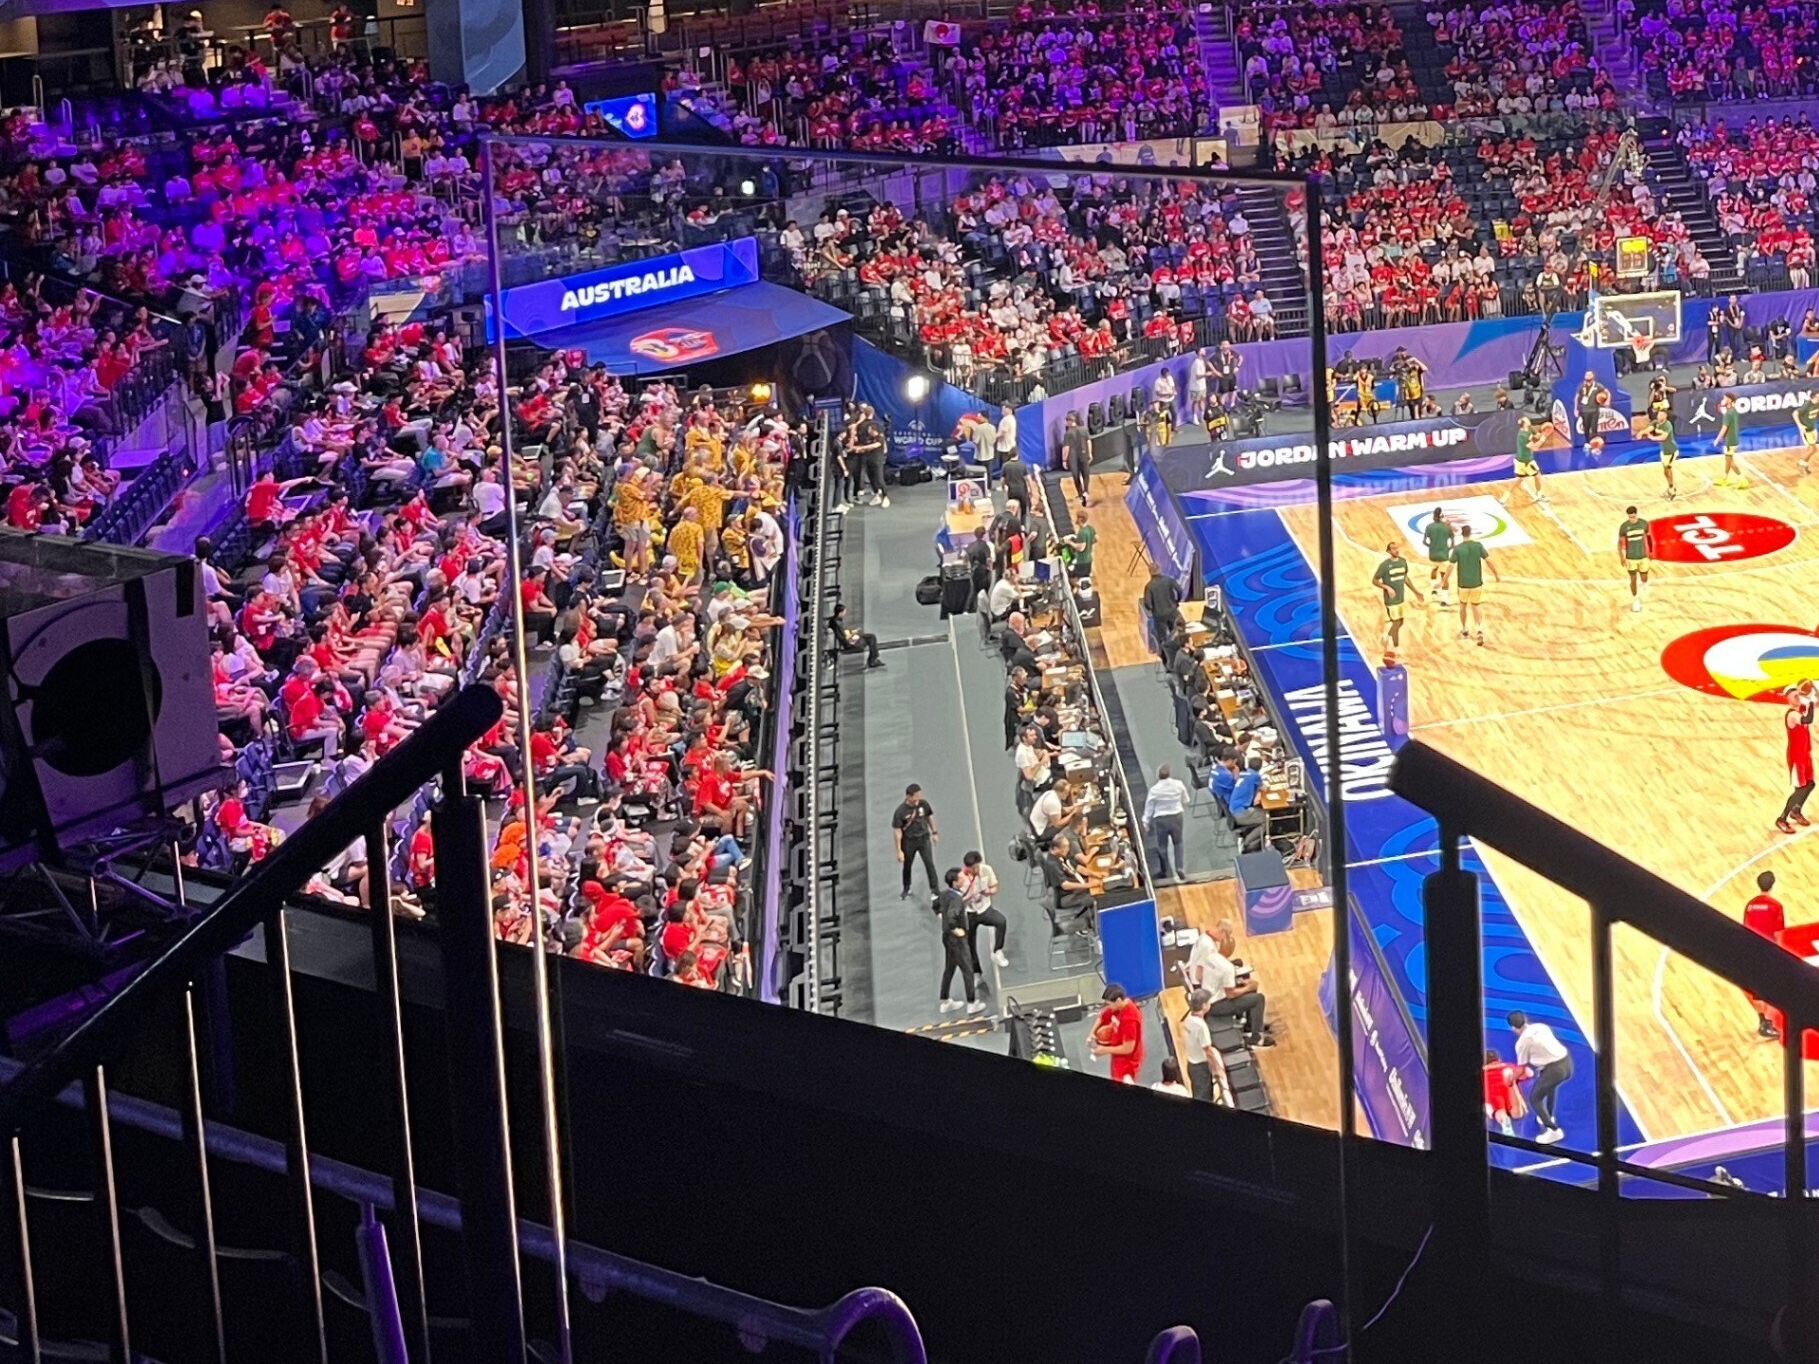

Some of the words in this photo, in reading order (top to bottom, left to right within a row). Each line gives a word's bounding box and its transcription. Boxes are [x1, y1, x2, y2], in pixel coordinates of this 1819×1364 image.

[561, 264, 696, 311] AUSTRALIA
[1240, 440, 1347, 469] JORDN
[1351, 433, 1428, 456] WARM
[1431, 428, 1468, 446] UP
[1672, 515, 1745, 561] TCL
